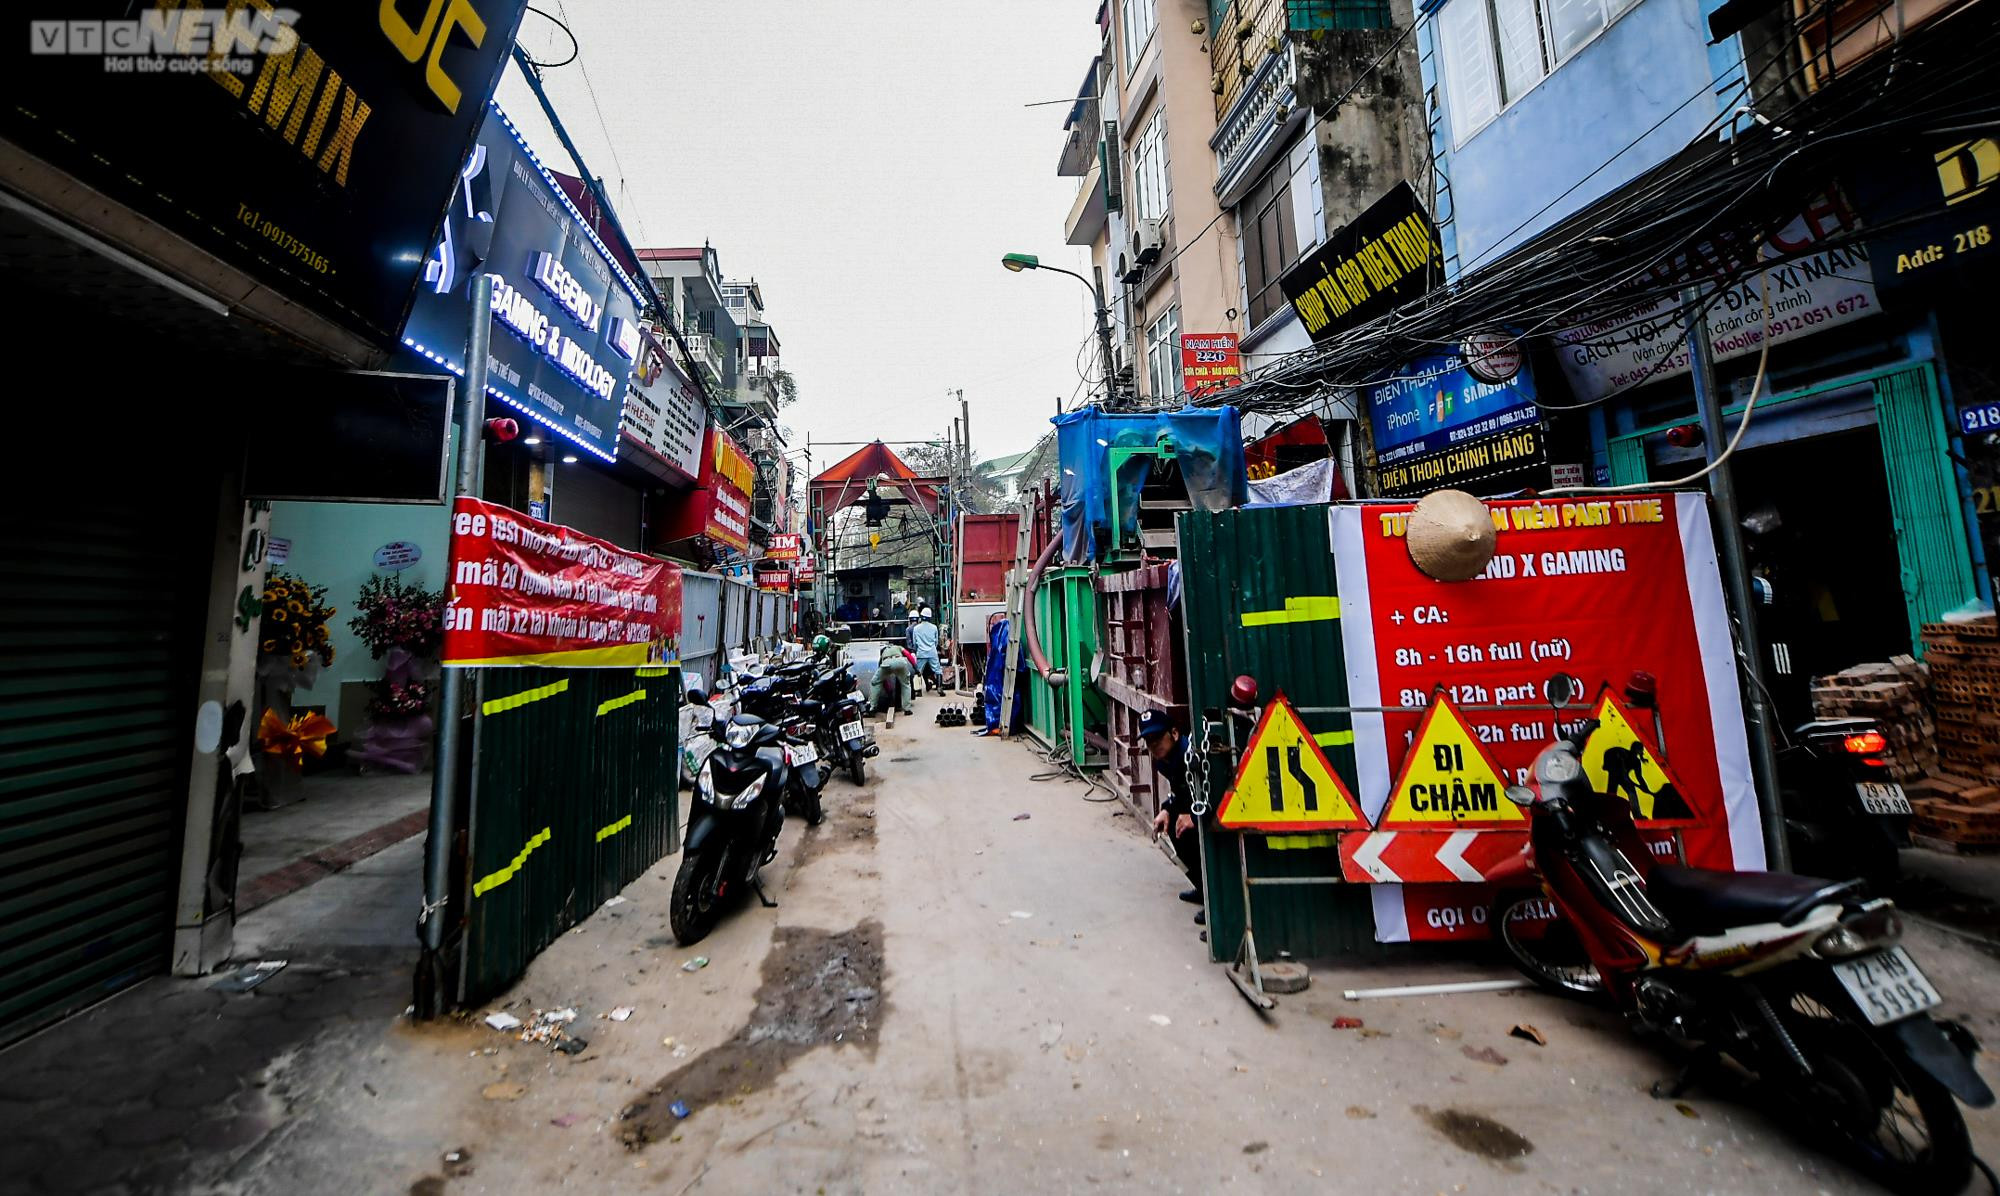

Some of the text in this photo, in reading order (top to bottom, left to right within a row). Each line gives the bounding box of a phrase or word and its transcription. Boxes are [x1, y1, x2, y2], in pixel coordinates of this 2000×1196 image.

[1896, 225, 1992, 274] Add: 218
[538, 253, 592, 322] LEGEND
[590, 303, 602, 333] X
[1295, 286, 1331, 334] SHOP
[1316, 261, 1352, 318] TRẢ
[1335, 255, 1371, 306] GÓP
[1356, 236, 1403, 294] ĐIỆN
[1714, 293, 1871, 356] Mobile: 0912 051 672
[1715, 314, 1744, 335] chân
[1775, 289, 1812, 314] trình)
[484, 273, 548, 346] GAMING
[548, 326, 561, 357] &
[560, 336, 616, 400] MIXOLOGY
[1185, 339, 1210, 350] NAM
[1196, 350, 1227, 363] 226
[1375, 371, 1401, 407] ĐIỆN
[1610, 374, 1631, 388] Tel:
[1387, 408, 1421, 431] iPhone
[1966, 407, 2000, 429] 218
[1382, 433, 1535, 490] ĐIỆN THOẠI CHÍNH HÃNG
[453, 511, 486, 537] ee
[491, 514, 519, 546] test
[1511, 501, 1560, 531] VIÊN
[1562, 500, 1612, 528] PART
[1613, 498, 1665, 523] TIME
[456, 557, 499, 586] mãi
[500, 561, 518, 589] 20
[573, 581, 586, 601] x3
[1521, 553, 1538, 578] X
[1541, 548, 1627, 577] GAMING
[481, 605, 510, 634] mãi
[511, 610, 530, 634] x2
[529, 609, 547, 636] tài
[547, 611, 578, 639] khoản
[1413, 606, 1449, 625] CA:
[1395, 647, 1422, 667] 8h
[1444, 644, 1483, 664] 16h
[1488, 641, 1523, 662] full
[1530, 638, 1572, 663] (nữ)
[1399, 688, 1428, 708] 8h
[1449, 684, 1489, 705] 12h
[1494, 682, 1537, 706] part
[1510, 721, 1545, 742] full
[1433, 744, 1464, 773] ĐI
[1409, 777, 1498, 821] CHẬM
[1426, 906, 1465, 933] GỌI
[1868, 978, 1931, 1018] 5995
